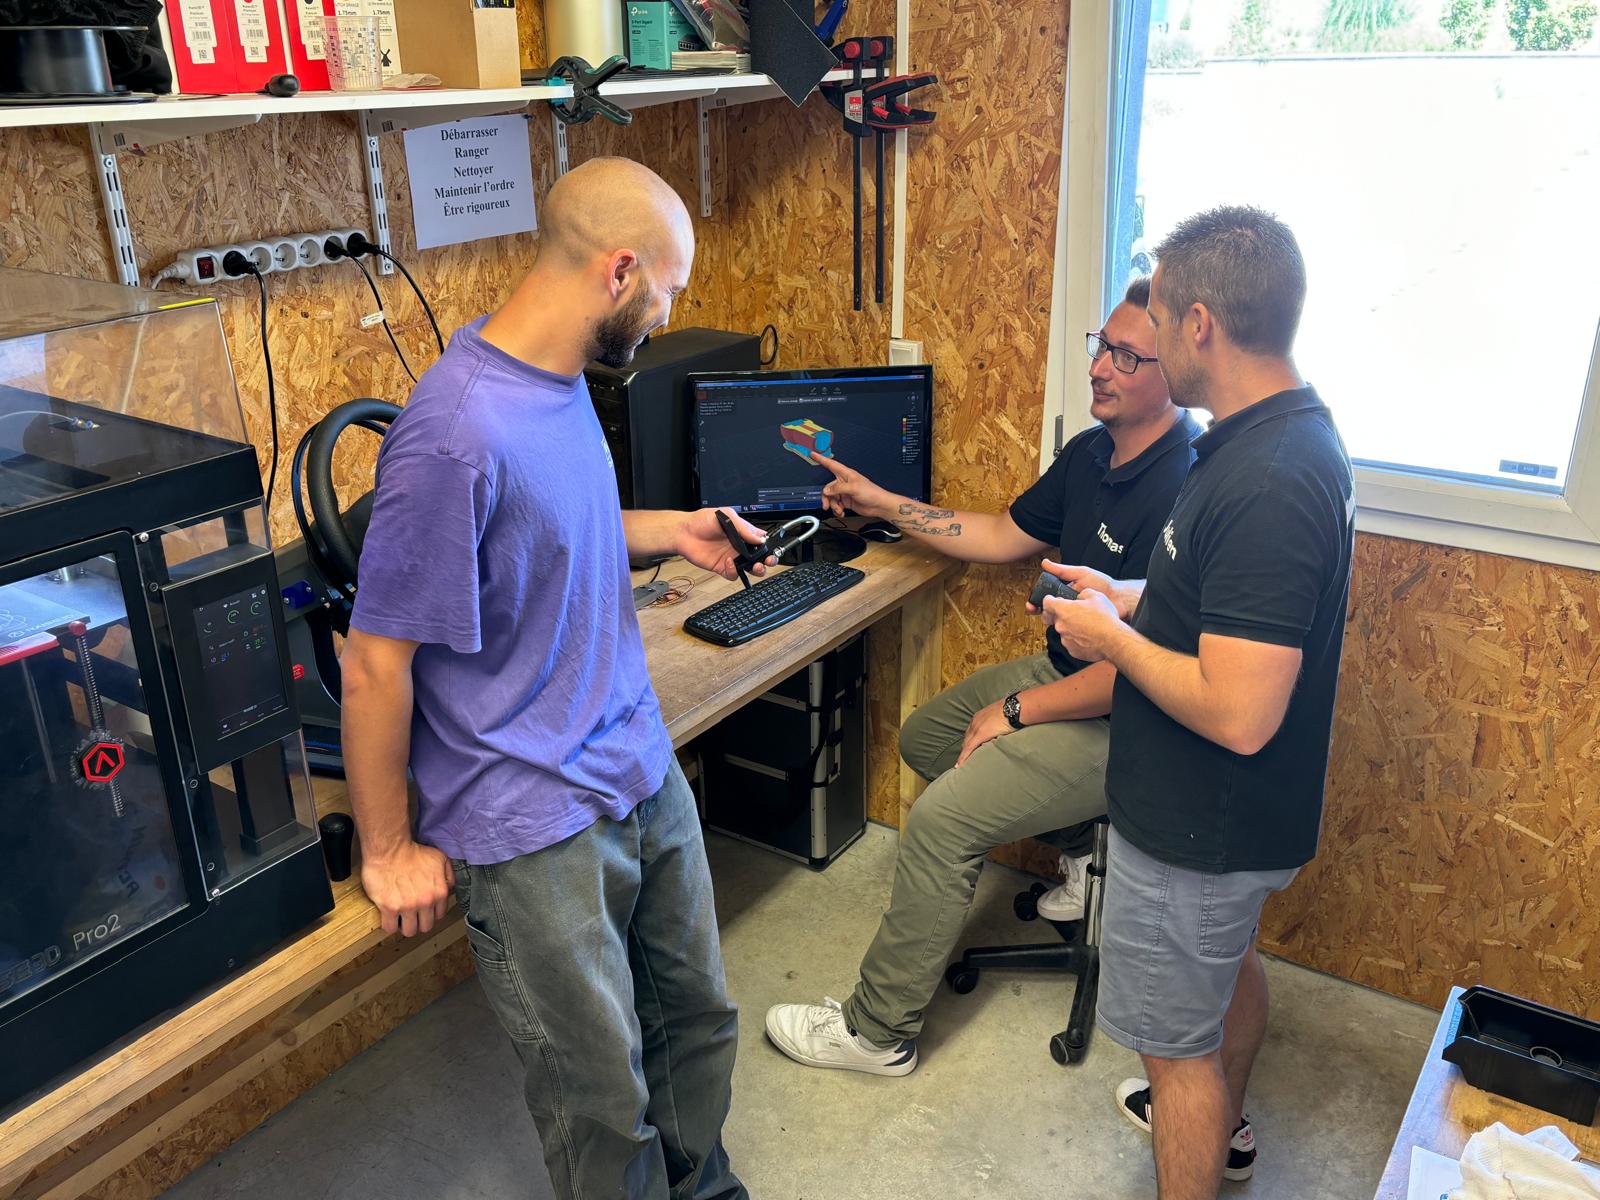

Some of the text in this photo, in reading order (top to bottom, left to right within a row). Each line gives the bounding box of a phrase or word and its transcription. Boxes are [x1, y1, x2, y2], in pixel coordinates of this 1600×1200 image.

[440, 127, 499, 141] Débarrasser
[454, 146, 489, 160] Ranger
[453, 165, 494, 178] Nettoyer
[434, 179, 515, 199] Maintenir l'ordre
[443, 199, 510, 217] Être rigoureux
[72, 914, 121, 951] Pro2
